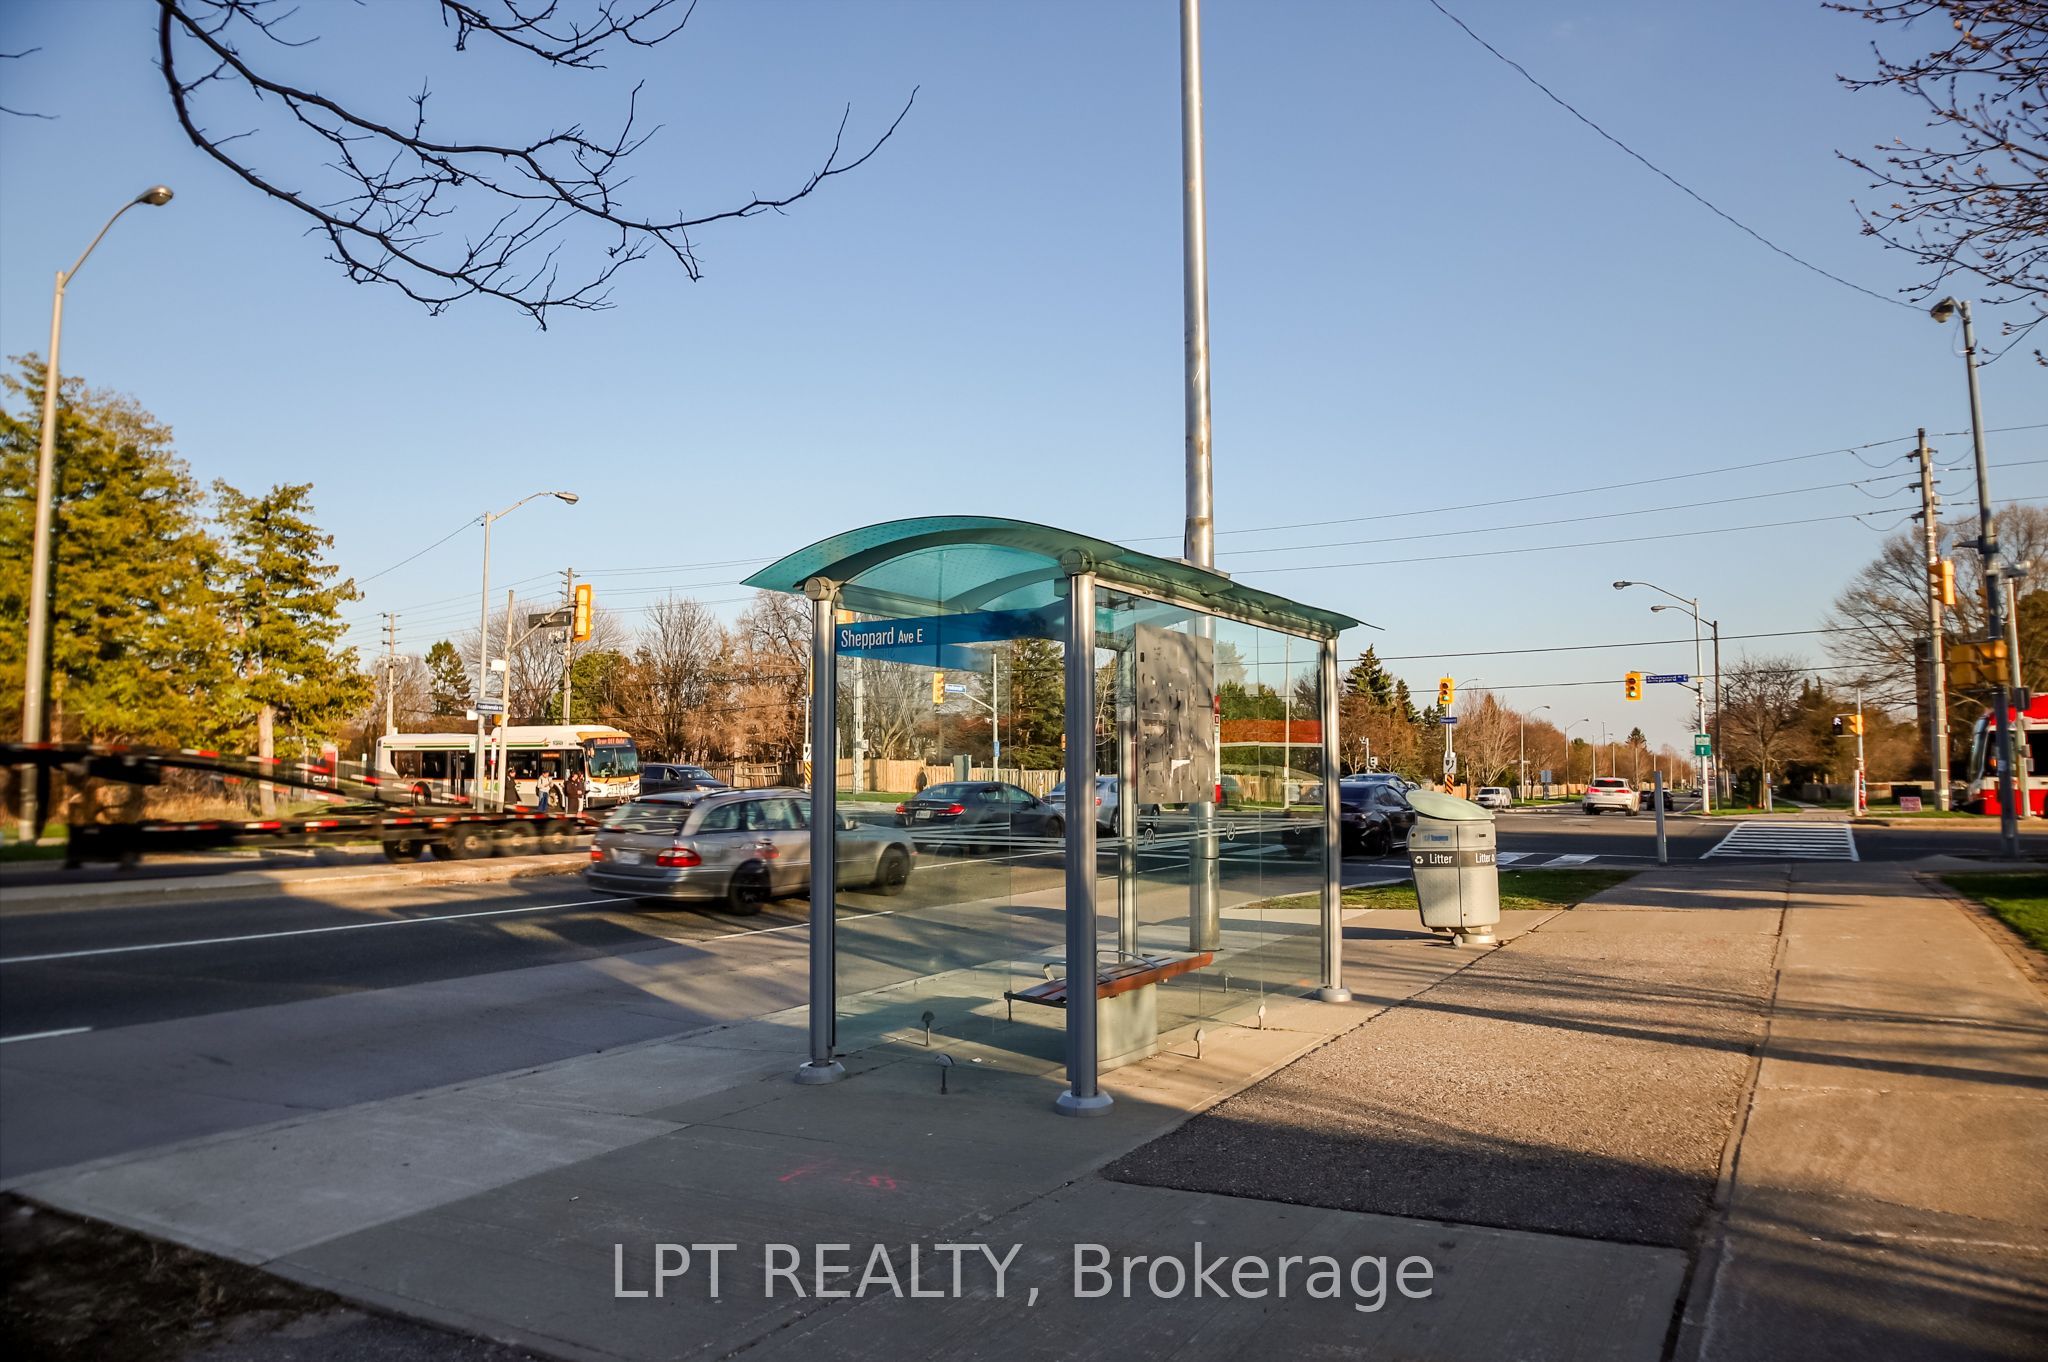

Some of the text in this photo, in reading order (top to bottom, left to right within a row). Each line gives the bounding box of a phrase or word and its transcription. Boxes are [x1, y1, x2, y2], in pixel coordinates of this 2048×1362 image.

[841, 626, 924, 650] Sheppard Ave E
[1429, 853, 1453, 864] Litter
[1475, 852, 1491, 864] Litter
